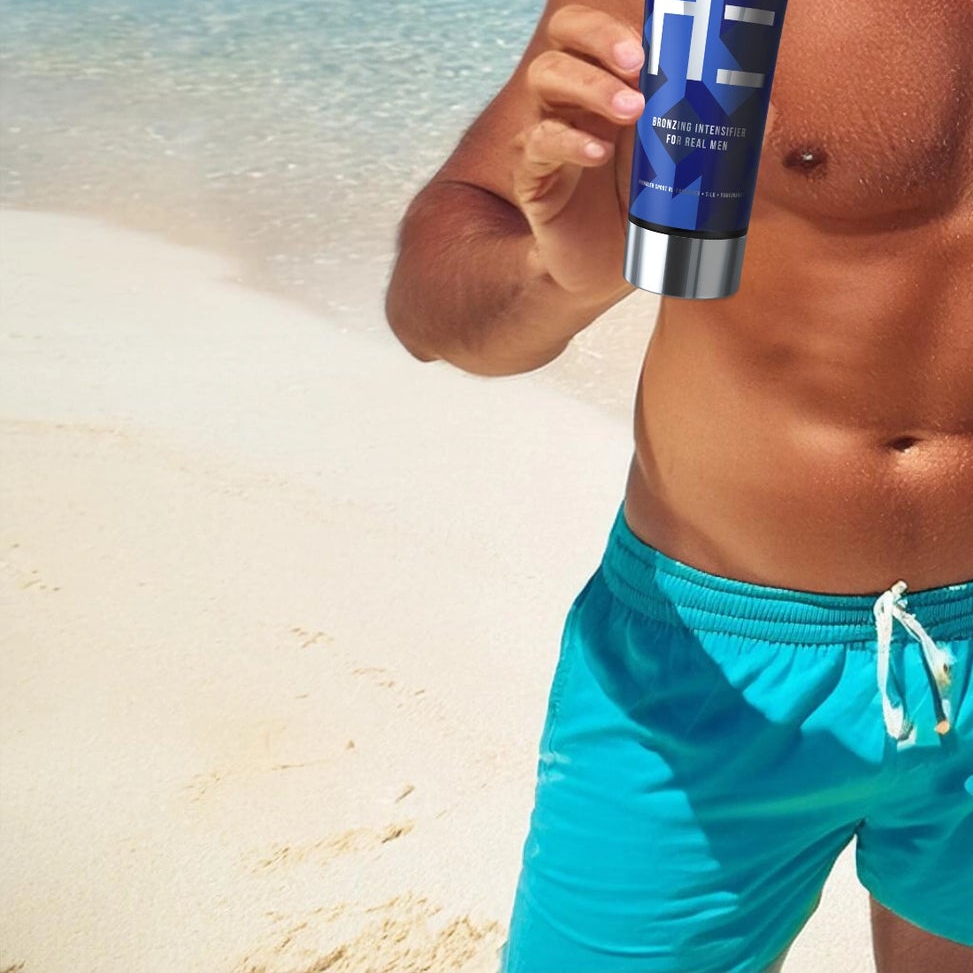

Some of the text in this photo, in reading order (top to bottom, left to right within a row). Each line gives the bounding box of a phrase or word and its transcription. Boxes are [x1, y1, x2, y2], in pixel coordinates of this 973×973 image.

[652, 116, 747, 138] BRONZING INTENSIFIER
[666, 133, 729, 151] FOR REAL MEN
